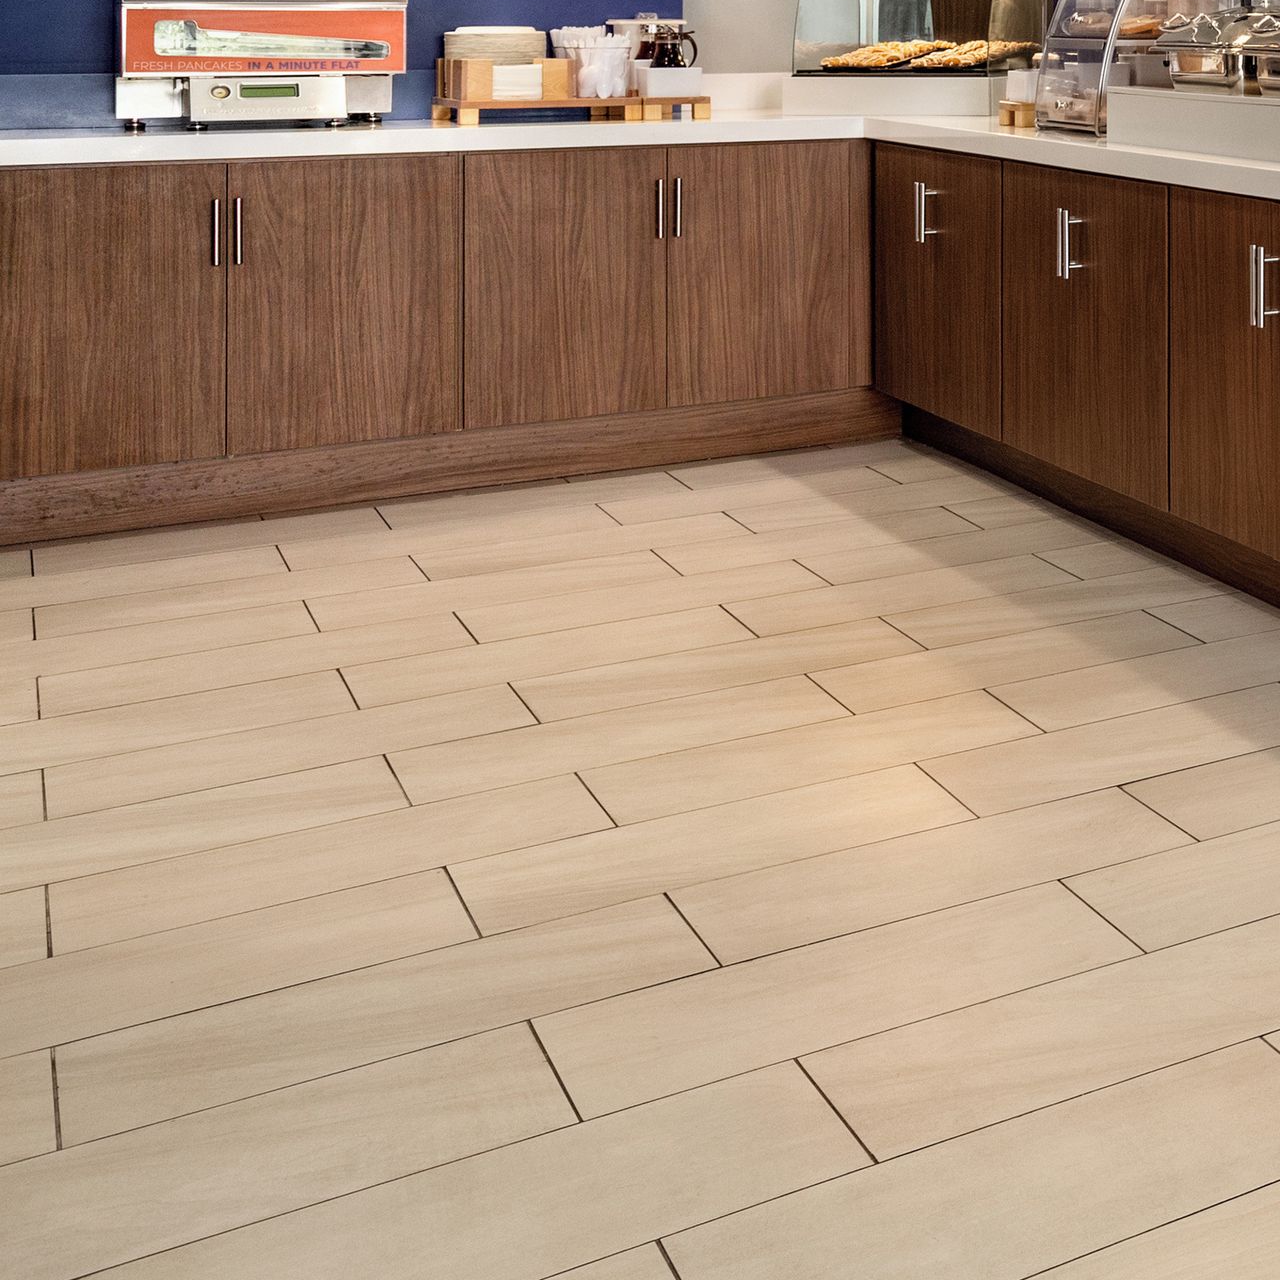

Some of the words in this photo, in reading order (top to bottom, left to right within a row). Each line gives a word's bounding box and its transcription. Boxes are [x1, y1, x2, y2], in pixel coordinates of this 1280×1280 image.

[133, 61, 174, 70] FRESH
[178, 61, 243, 70] PANCAKES
[247, 61, 261, 69] IN
[265, 61, 275, 69] A
[278, 61, 327, 70] MINUTE
[331, 60, 361, 69] FLAT
